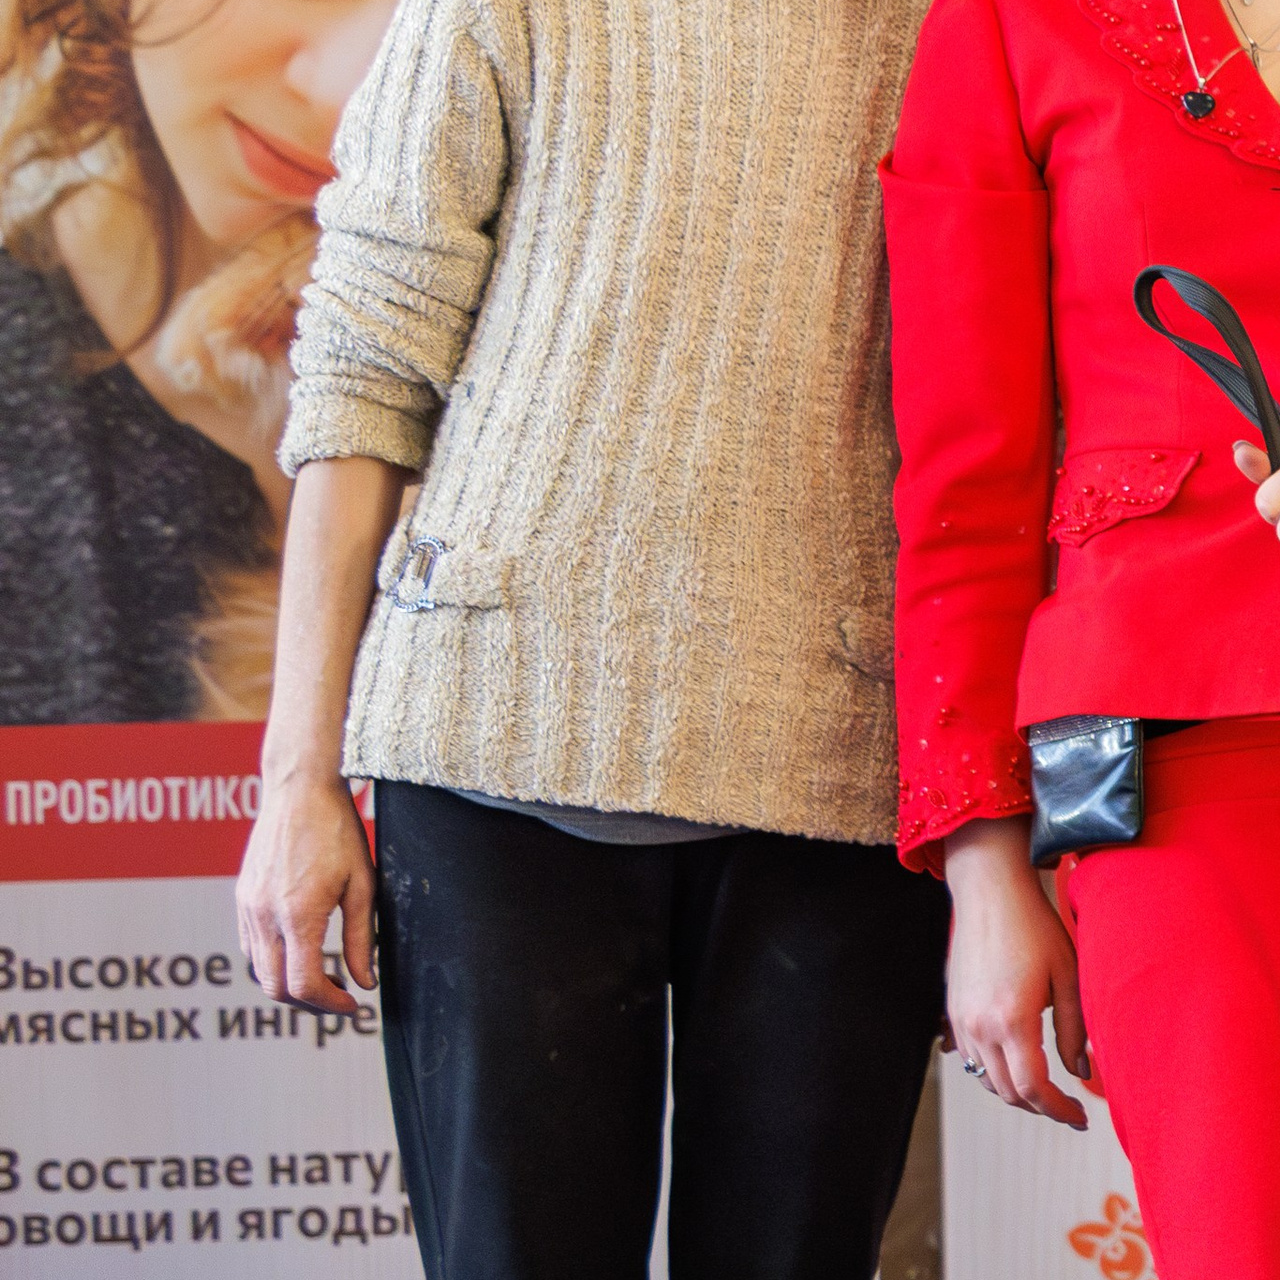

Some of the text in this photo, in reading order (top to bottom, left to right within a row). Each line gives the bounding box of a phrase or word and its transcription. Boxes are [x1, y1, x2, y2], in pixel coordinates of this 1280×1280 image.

[6, 775, 262, 826] ПРОБИОТИКО
[218, 1003, 378, 1047] ингре
[36, 1153, 254, 1193] составе
[268, 1151, 409, 1195] нату
[191, 1208, 221, 1243] и
[238, 1204, 413, 1247] ягоды
